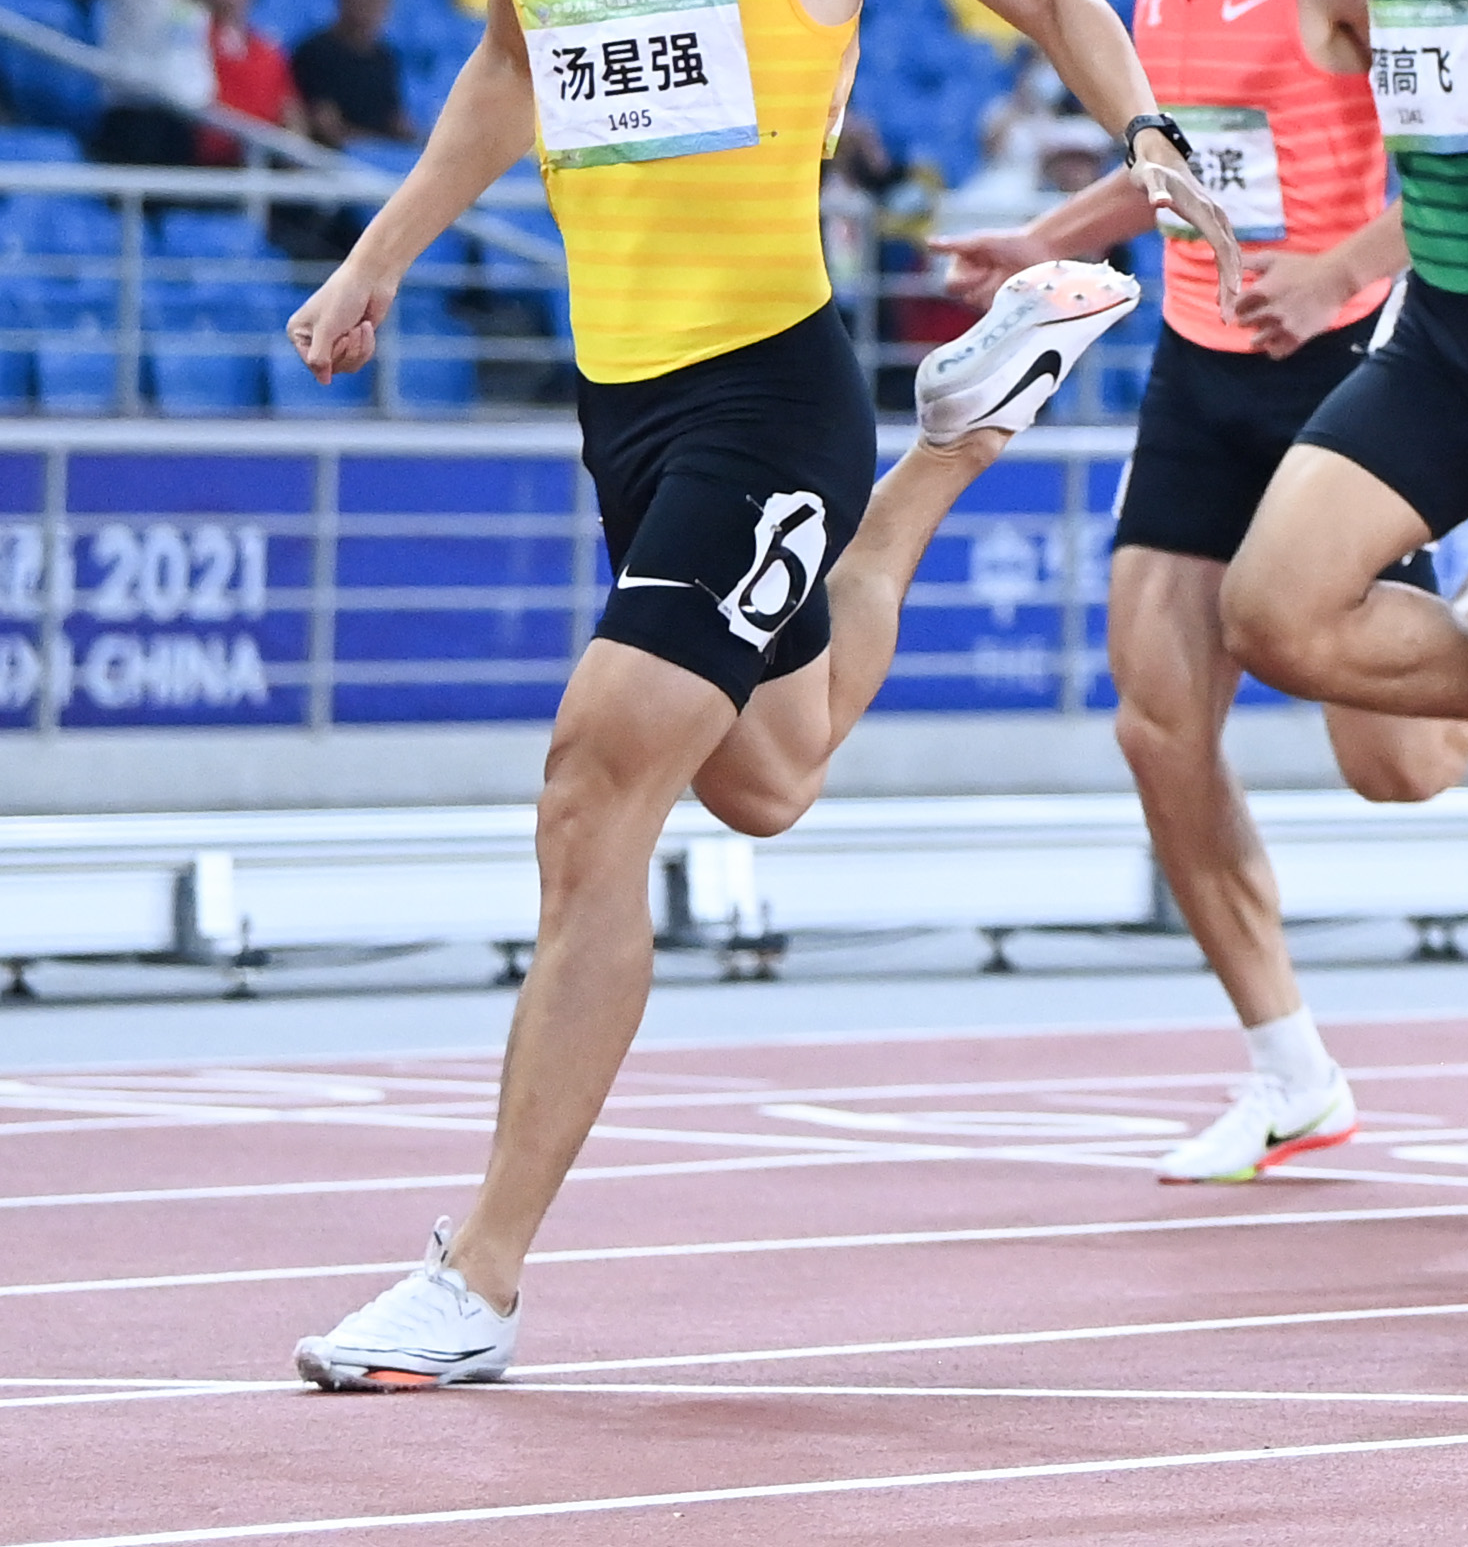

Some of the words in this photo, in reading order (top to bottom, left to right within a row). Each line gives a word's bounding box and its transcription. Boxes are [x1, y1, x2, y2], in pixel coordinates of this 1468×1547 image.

[552, 32, 709, 101] 汤星强
[607, 109, 652, 132] 1495
[94, 523, 268, 621] 2021
[738, 503, 817, 633] 6
[82, 633, 269, 710] CHINA
